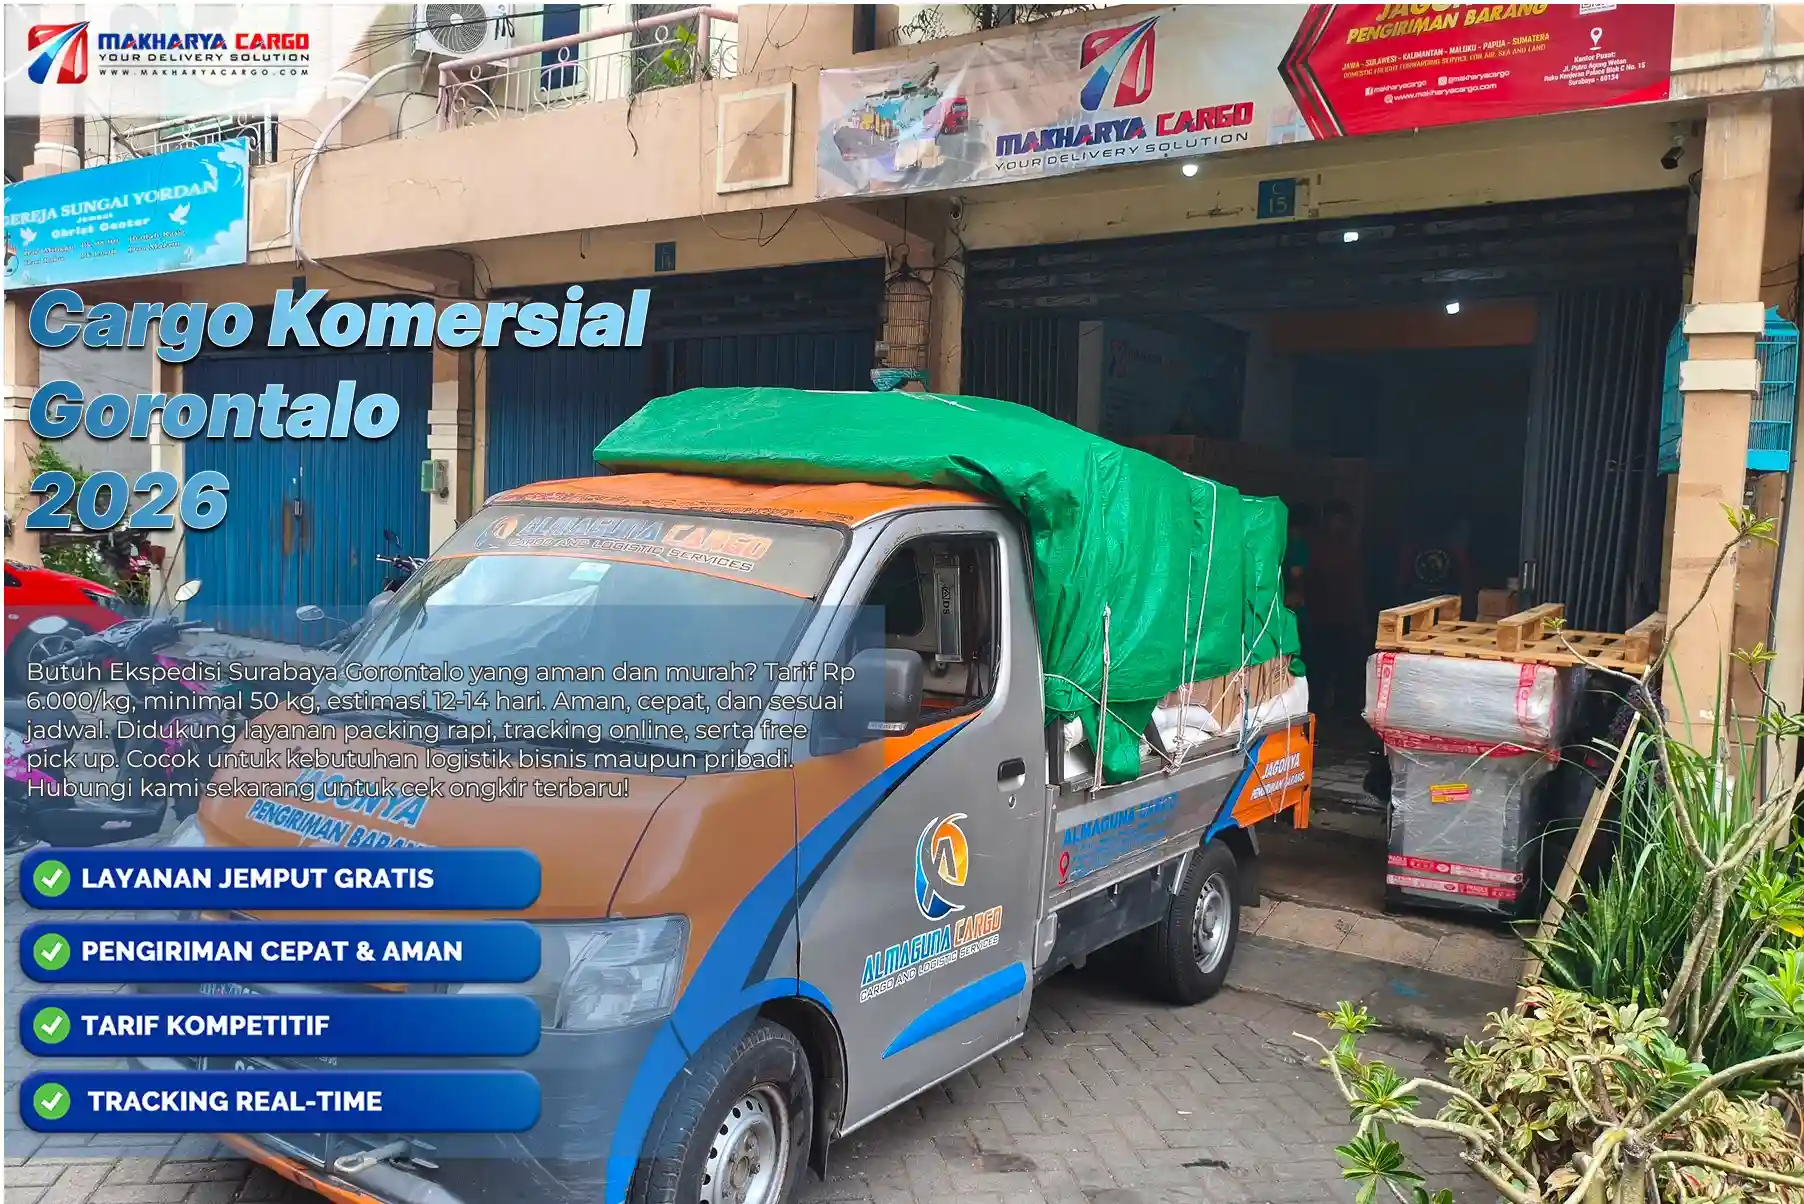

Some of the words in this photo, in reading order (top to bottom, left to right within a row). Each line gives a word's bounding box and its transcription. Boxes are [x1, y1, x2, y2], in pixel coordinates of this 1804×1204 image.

[1346, 12, 1459, 44] PENGIRIMAN
[1463, 4, 1549, 27] BARANG
[1342, 61, 1360, 70] JAWA
[1366, 55, 1398, 67] SULAWESI
[1402, 48, 1444, 60] KALIMANTAN
[1449, 44, 1477, 54] MALUKU
[1483, 40, 1506, 50] PAPUA
[1512, 33, 1550, 45] SUMATERA
[1574, 55, 1595, 63] Kantor
[1373, 80, 1427, 93] makharyacargo
[1394, 83, 1497, 101] www.makharyacargo.com
[996, 116, 1147, 157] MAKHARYA
[1156, 101, 1255, 137] CARGO
[995, 157, 1042, 172] YOUR
[1047, 145, 1140, 165] DELIVERY
[1145, 131, 1249, 153] SOLUTION
[60, 194, 130, 218] SUNGAI
[132, 180, 220, 206] YORDAN
[1269, 196, 1288, 214] 15
[51, 224, 95, 240] Christ
[592, 540, 665, 557] LOGISTIC
[667, 547, 755, 573] SERVICES
[661, 523, 775, 560] CARGO
[245, 797, 352, 845] PENGIRIMAN
[1063, 807, 1136, 847] ALMAGUNA
[861, 923, 951, 989] ALMAGUNA
[953, 905, 1003, 949] CARGO
[859, 978, 895, 1004] CARGO
[894, 968, 917, 988] AND
[918, 950, 959, 977] LOGISTIC
[959, 934, 1000, 959] SERVICES
